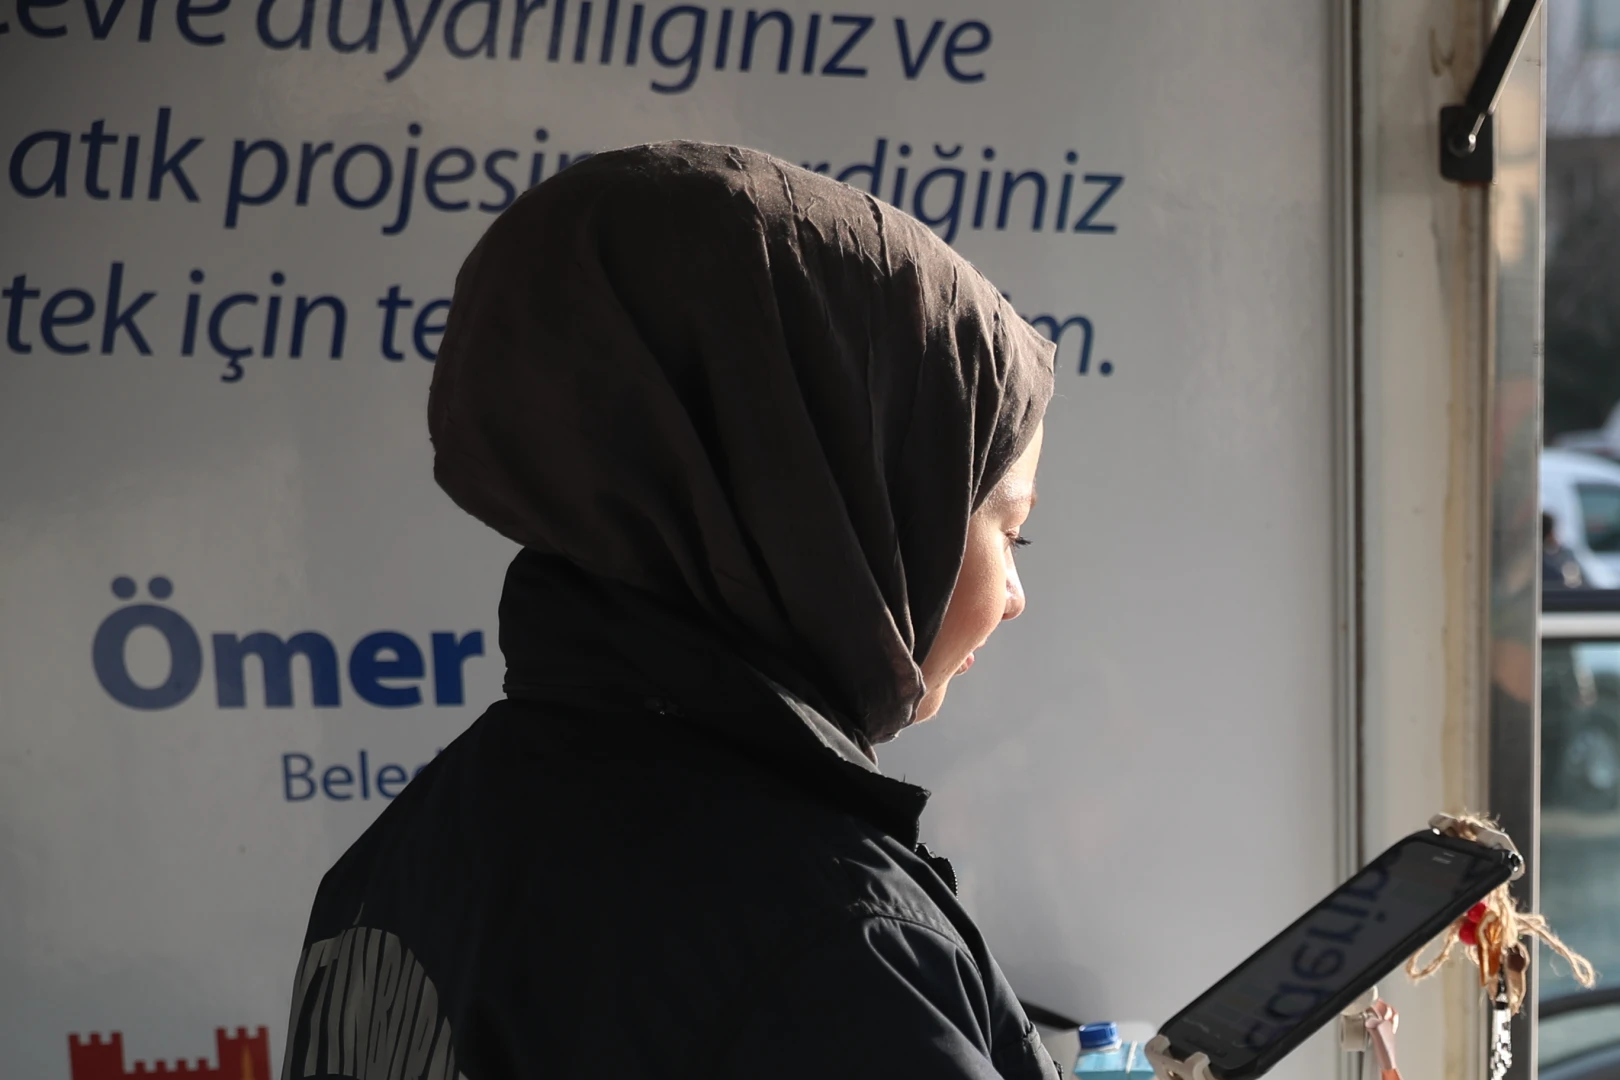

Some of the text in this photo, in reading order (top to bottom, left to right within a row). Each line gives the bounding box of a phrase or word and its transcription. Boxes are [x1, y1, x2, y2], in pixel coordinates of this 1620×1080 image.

[0, 0, 227, 47] evre
[893, 16, 993, 84] ve
[8, 106, 206, 201] atık
[223, 122, 598, 236] projesi
[1, 261, 159, 357] tek
[180, 268, 348, 384] için
[92, 574, 486, 712] Ömer
[281, 748, 445, 803] Bele
